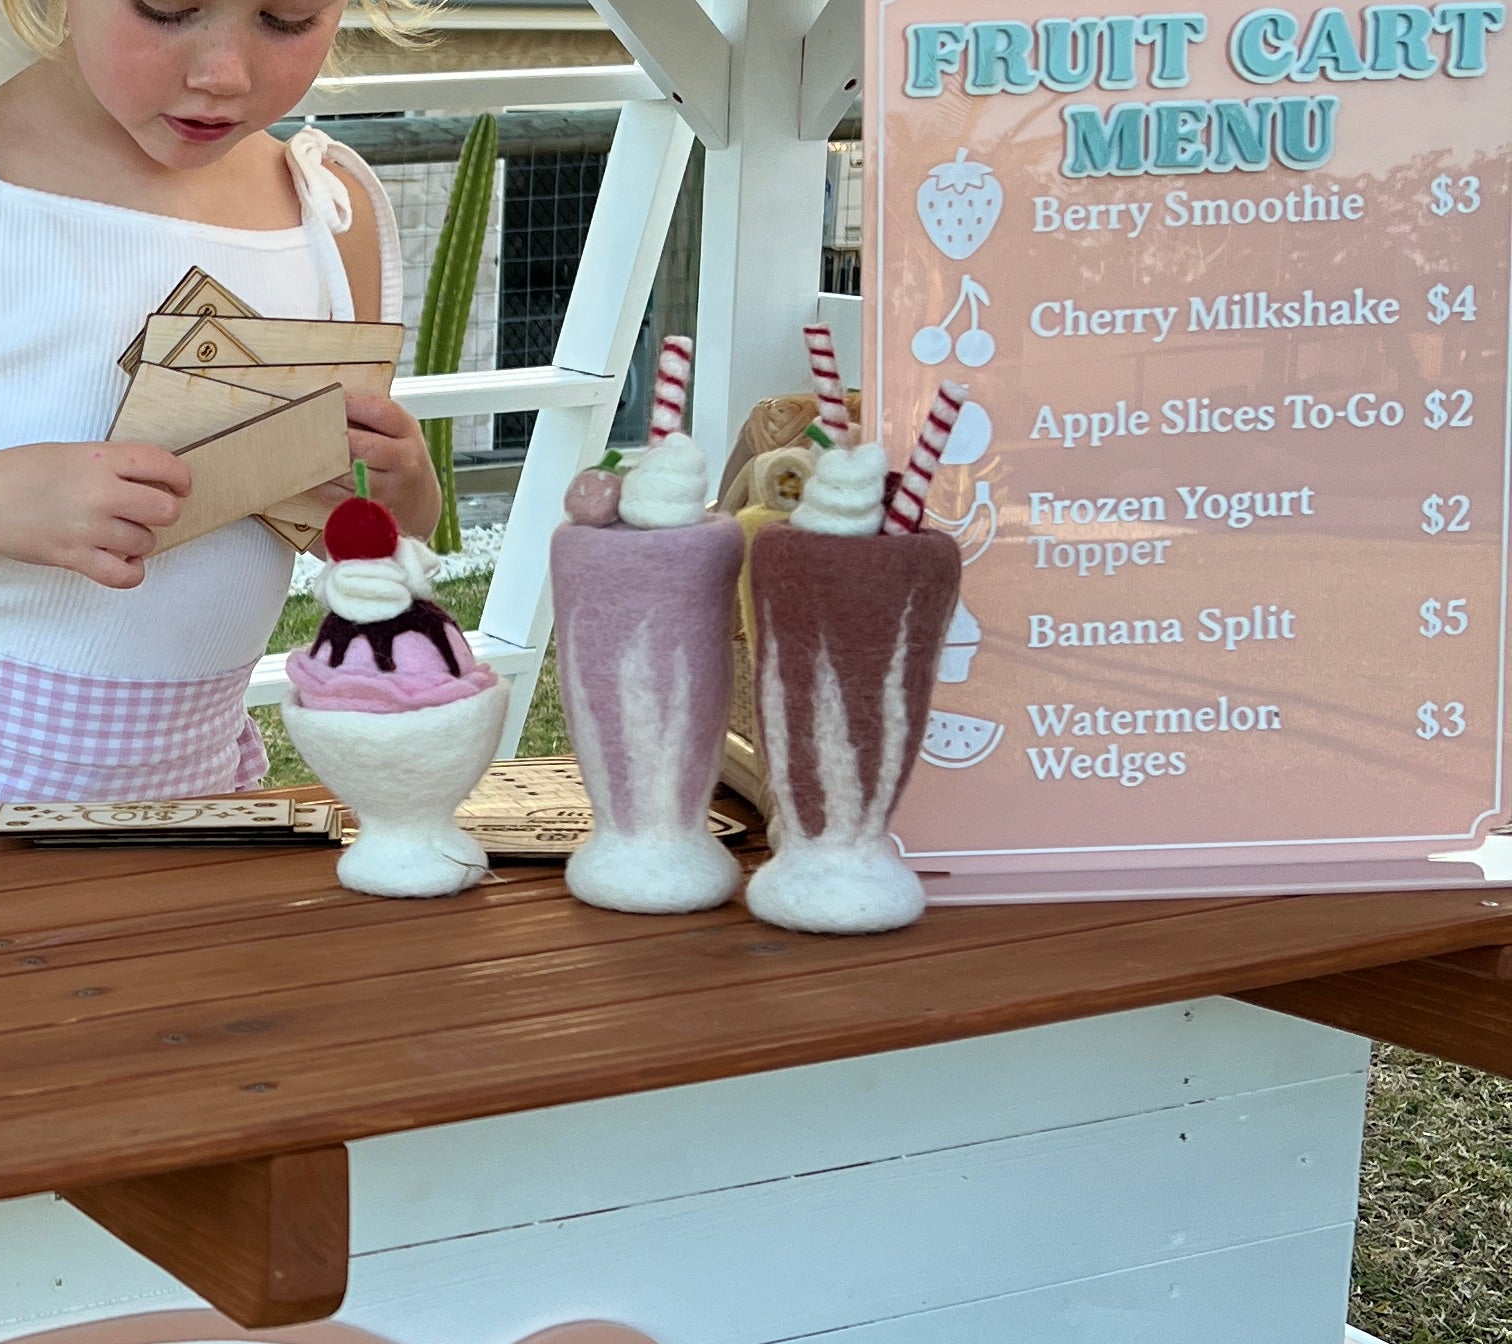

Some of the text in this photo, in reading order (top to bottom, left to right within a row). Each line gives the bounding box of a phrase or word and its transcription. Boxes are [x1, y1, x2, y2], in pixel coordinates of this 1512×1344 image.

[904, 2, 1506, 98] FRUIT CART
[1060, 95, 1339, 178] MENU
[1032, 174, 1482, 238] Berry Smoothie $3
[1030, 285, 1478, 343] Cherry Milkshake $4
[1029, 389, 1474, 448] Apple Slices To-Go $2
[1028, 484, 1471, 535] Frozen Yogurt $2
[1028, 533, 1172, 576] Topper
[1027, 598, 1469, 650] Banana Split $5
[1027, 697, 1466, 740] Watermelon $3
[1027, 744, 1187, 786] Wedges
[110, 810, 177, 822] $10
